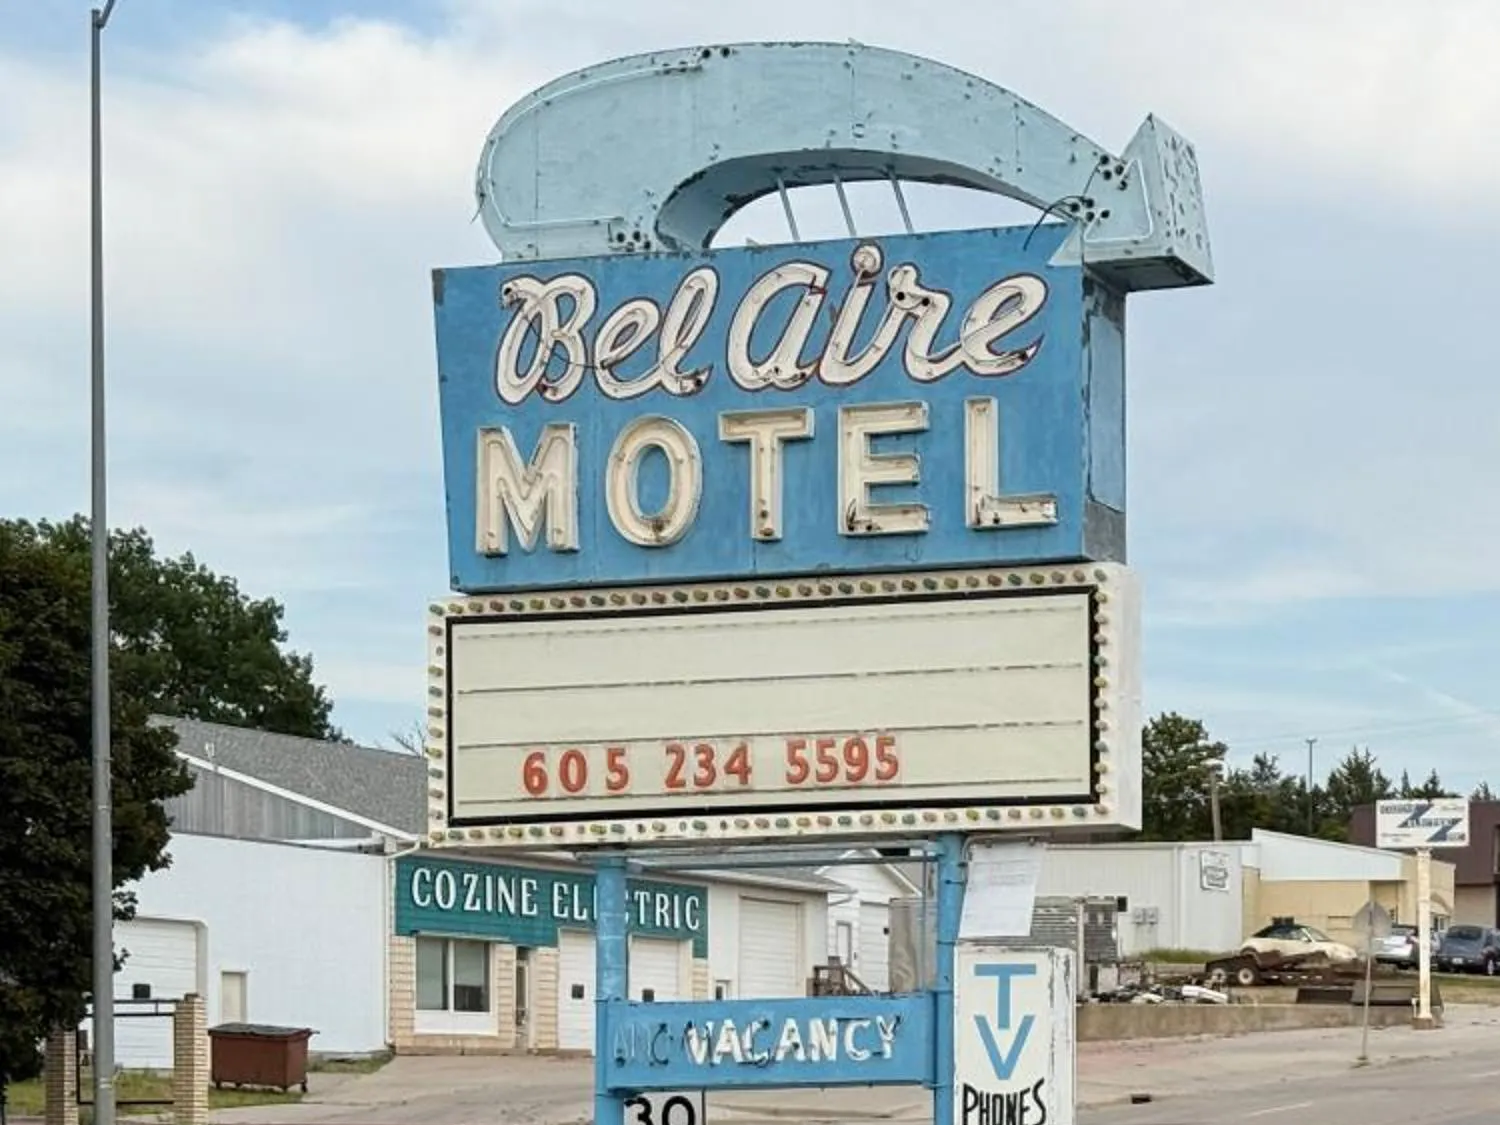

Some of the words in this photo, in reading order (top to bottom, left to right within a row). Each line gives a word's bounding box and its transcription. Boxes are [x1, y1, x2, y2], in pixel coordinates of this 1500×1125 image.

[496, 266, 719, 404] Bel
[726, 244, 1047, 391] Aire
[475, 397, 1060, 558] MOTEL
[523, 748, 629, 796] 605
[664, 740, 752, 789] 234
[785, 736, 899, 785] 5595
[411, 867, 538, 916] COZINE
[553, 882, 699, 931] ELTRIC
[683, 1014, 900, 1067] VACANCY
